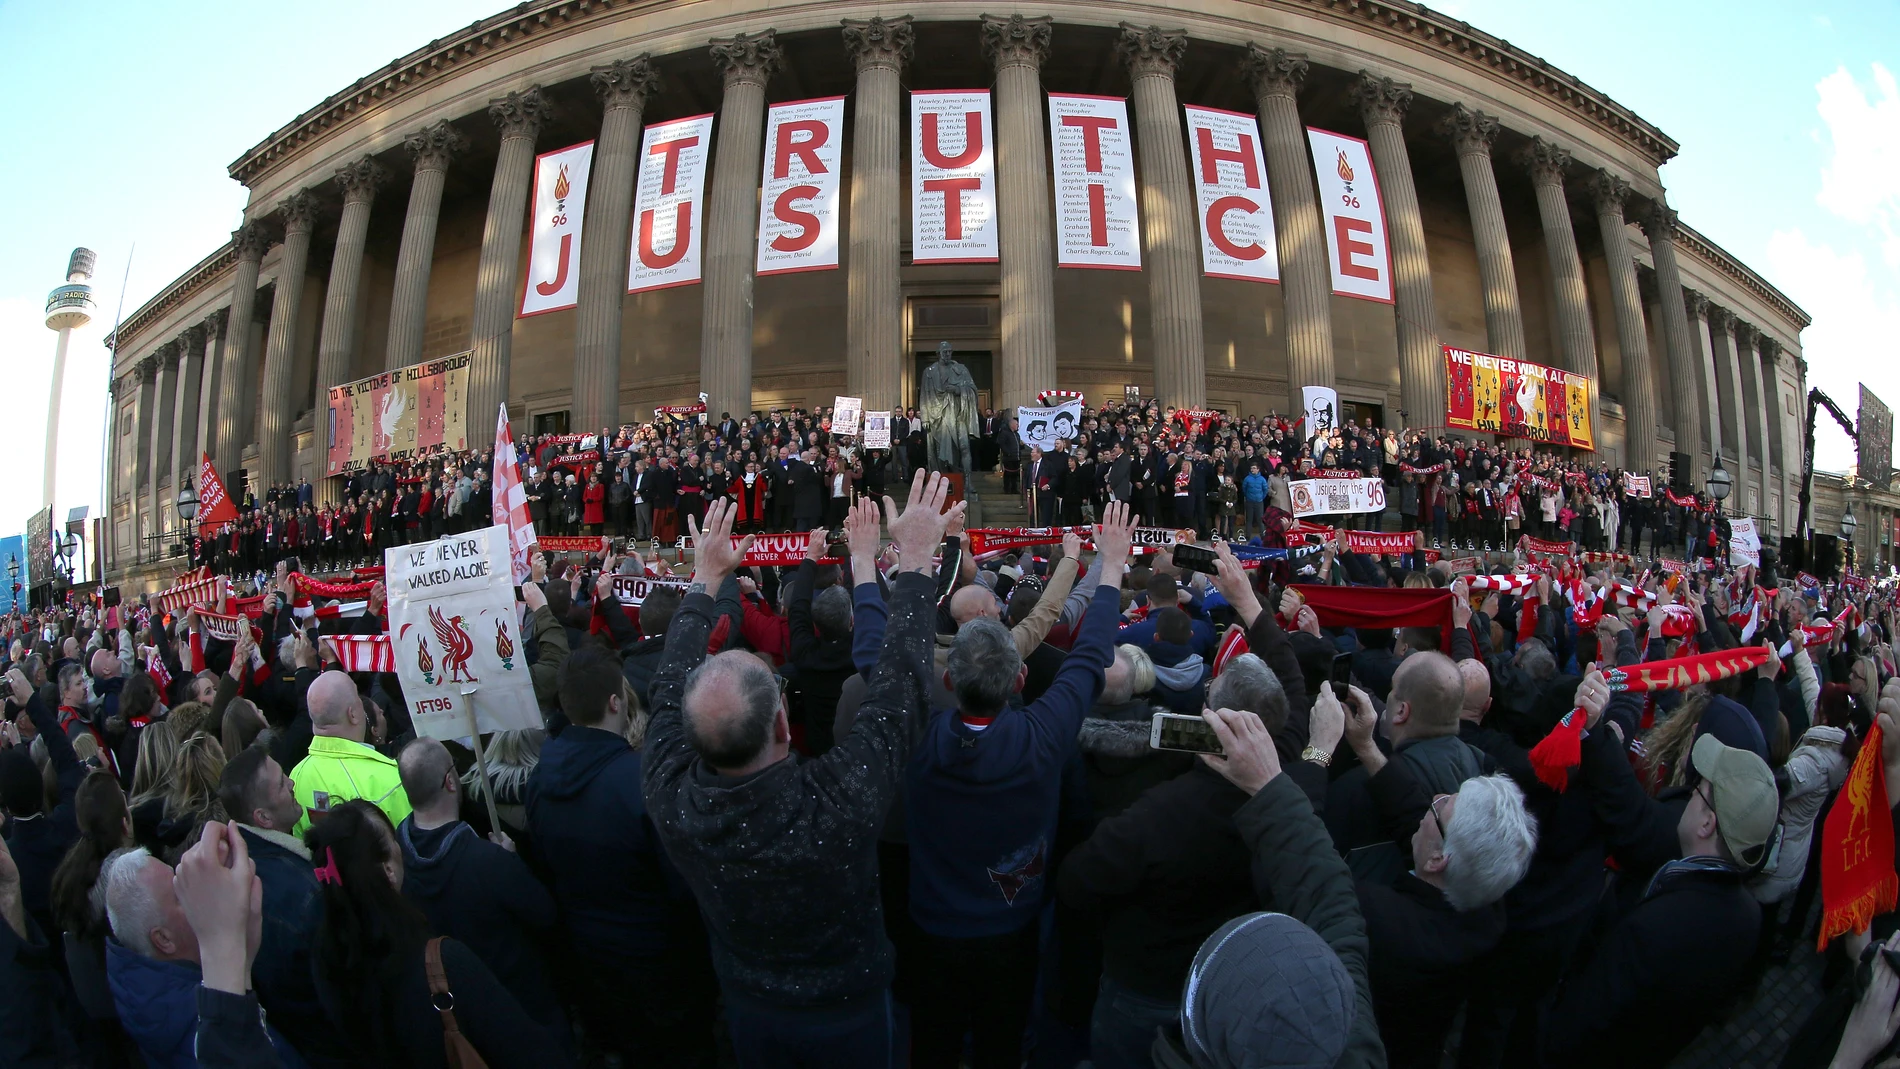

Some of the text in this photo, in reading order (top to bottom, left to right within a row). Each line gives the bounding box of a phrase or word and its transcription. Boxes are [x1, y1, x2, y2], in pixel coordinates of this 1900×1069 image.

[774, 120, 829, 179] R
[922, 112, 983, 169] U
[1062, 115, 1117, 172] T
[650, 136, 699, 195] T
[1197, 128, 1261, 189] H
[924, 178, 980, 240] T
[1342, 195, 1360, 208] 96
[552, 213, 567, 227] 96
[770, 185, 821, 252] S
[1206, 196, 1266, 260] C
[536, 233, 572, 296] J
[1333, 215, 1379, 281] E
[665, 266, 678, 275] Gary
[330, 354, 471, 400] TO THE VICTIMS OF HILLSBOROUGH
[1450, 349, 1585, 388] WE NEVER WALK ALONE
[1477, 419, 1568, 443] HILLSBOROUGH
[559, 454, 583, 462] JUSTICE
[202, 481, 220, 504] OUR
[211, 489, 225, 507] WAY
[1340, 482, 1348, 495] for
[1351, 482, 1363, 494] the
[1367, 481, 1383, 507] 96
[410, 540, 478, 568] WE NEVER
[992, 537, 1011, 545] TIMES
[409, 561, 488, 589] WALKED ALONE
[416, 697, 452, 714] JFT96
